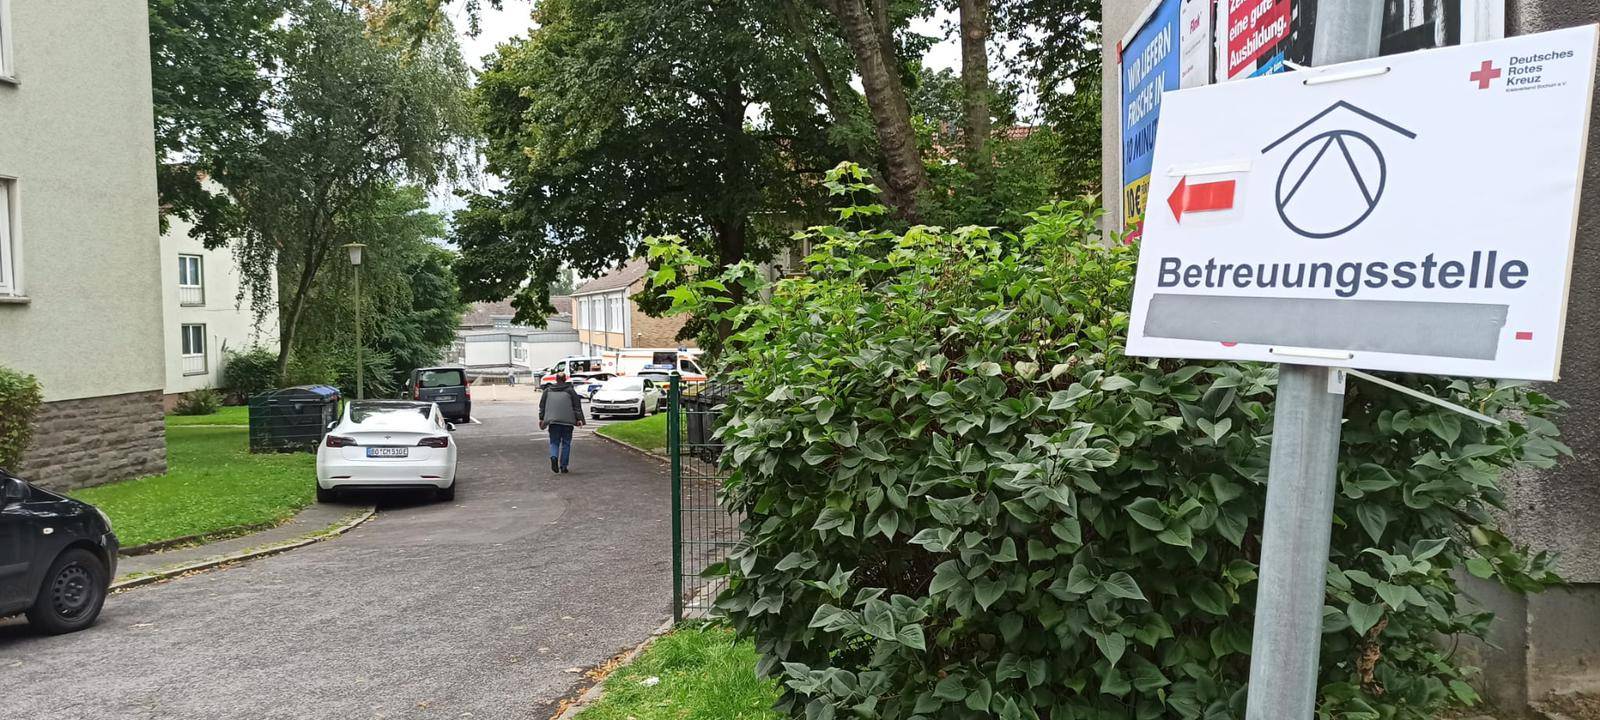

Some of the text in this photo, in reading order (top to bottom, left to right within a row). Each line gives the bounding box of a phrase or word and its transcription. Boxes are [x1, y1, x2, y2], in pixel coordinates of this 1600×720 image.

[1229, 15, 1287, 70] Ausbildung.
[1230, 0, 1273, 41] eine gute
[1127, 21, 1171, 94] WIR LIEFERN
[1508, 65, 1543, 76] Rotes
[1509, 50, 1574, 66] Deutsches
[1127, 70, 1165, 130] FRISCHE IN
[1506, 75, 1541, 86] Kreuz
[1157, 250, 1529, 297] Betreuungsstelle
